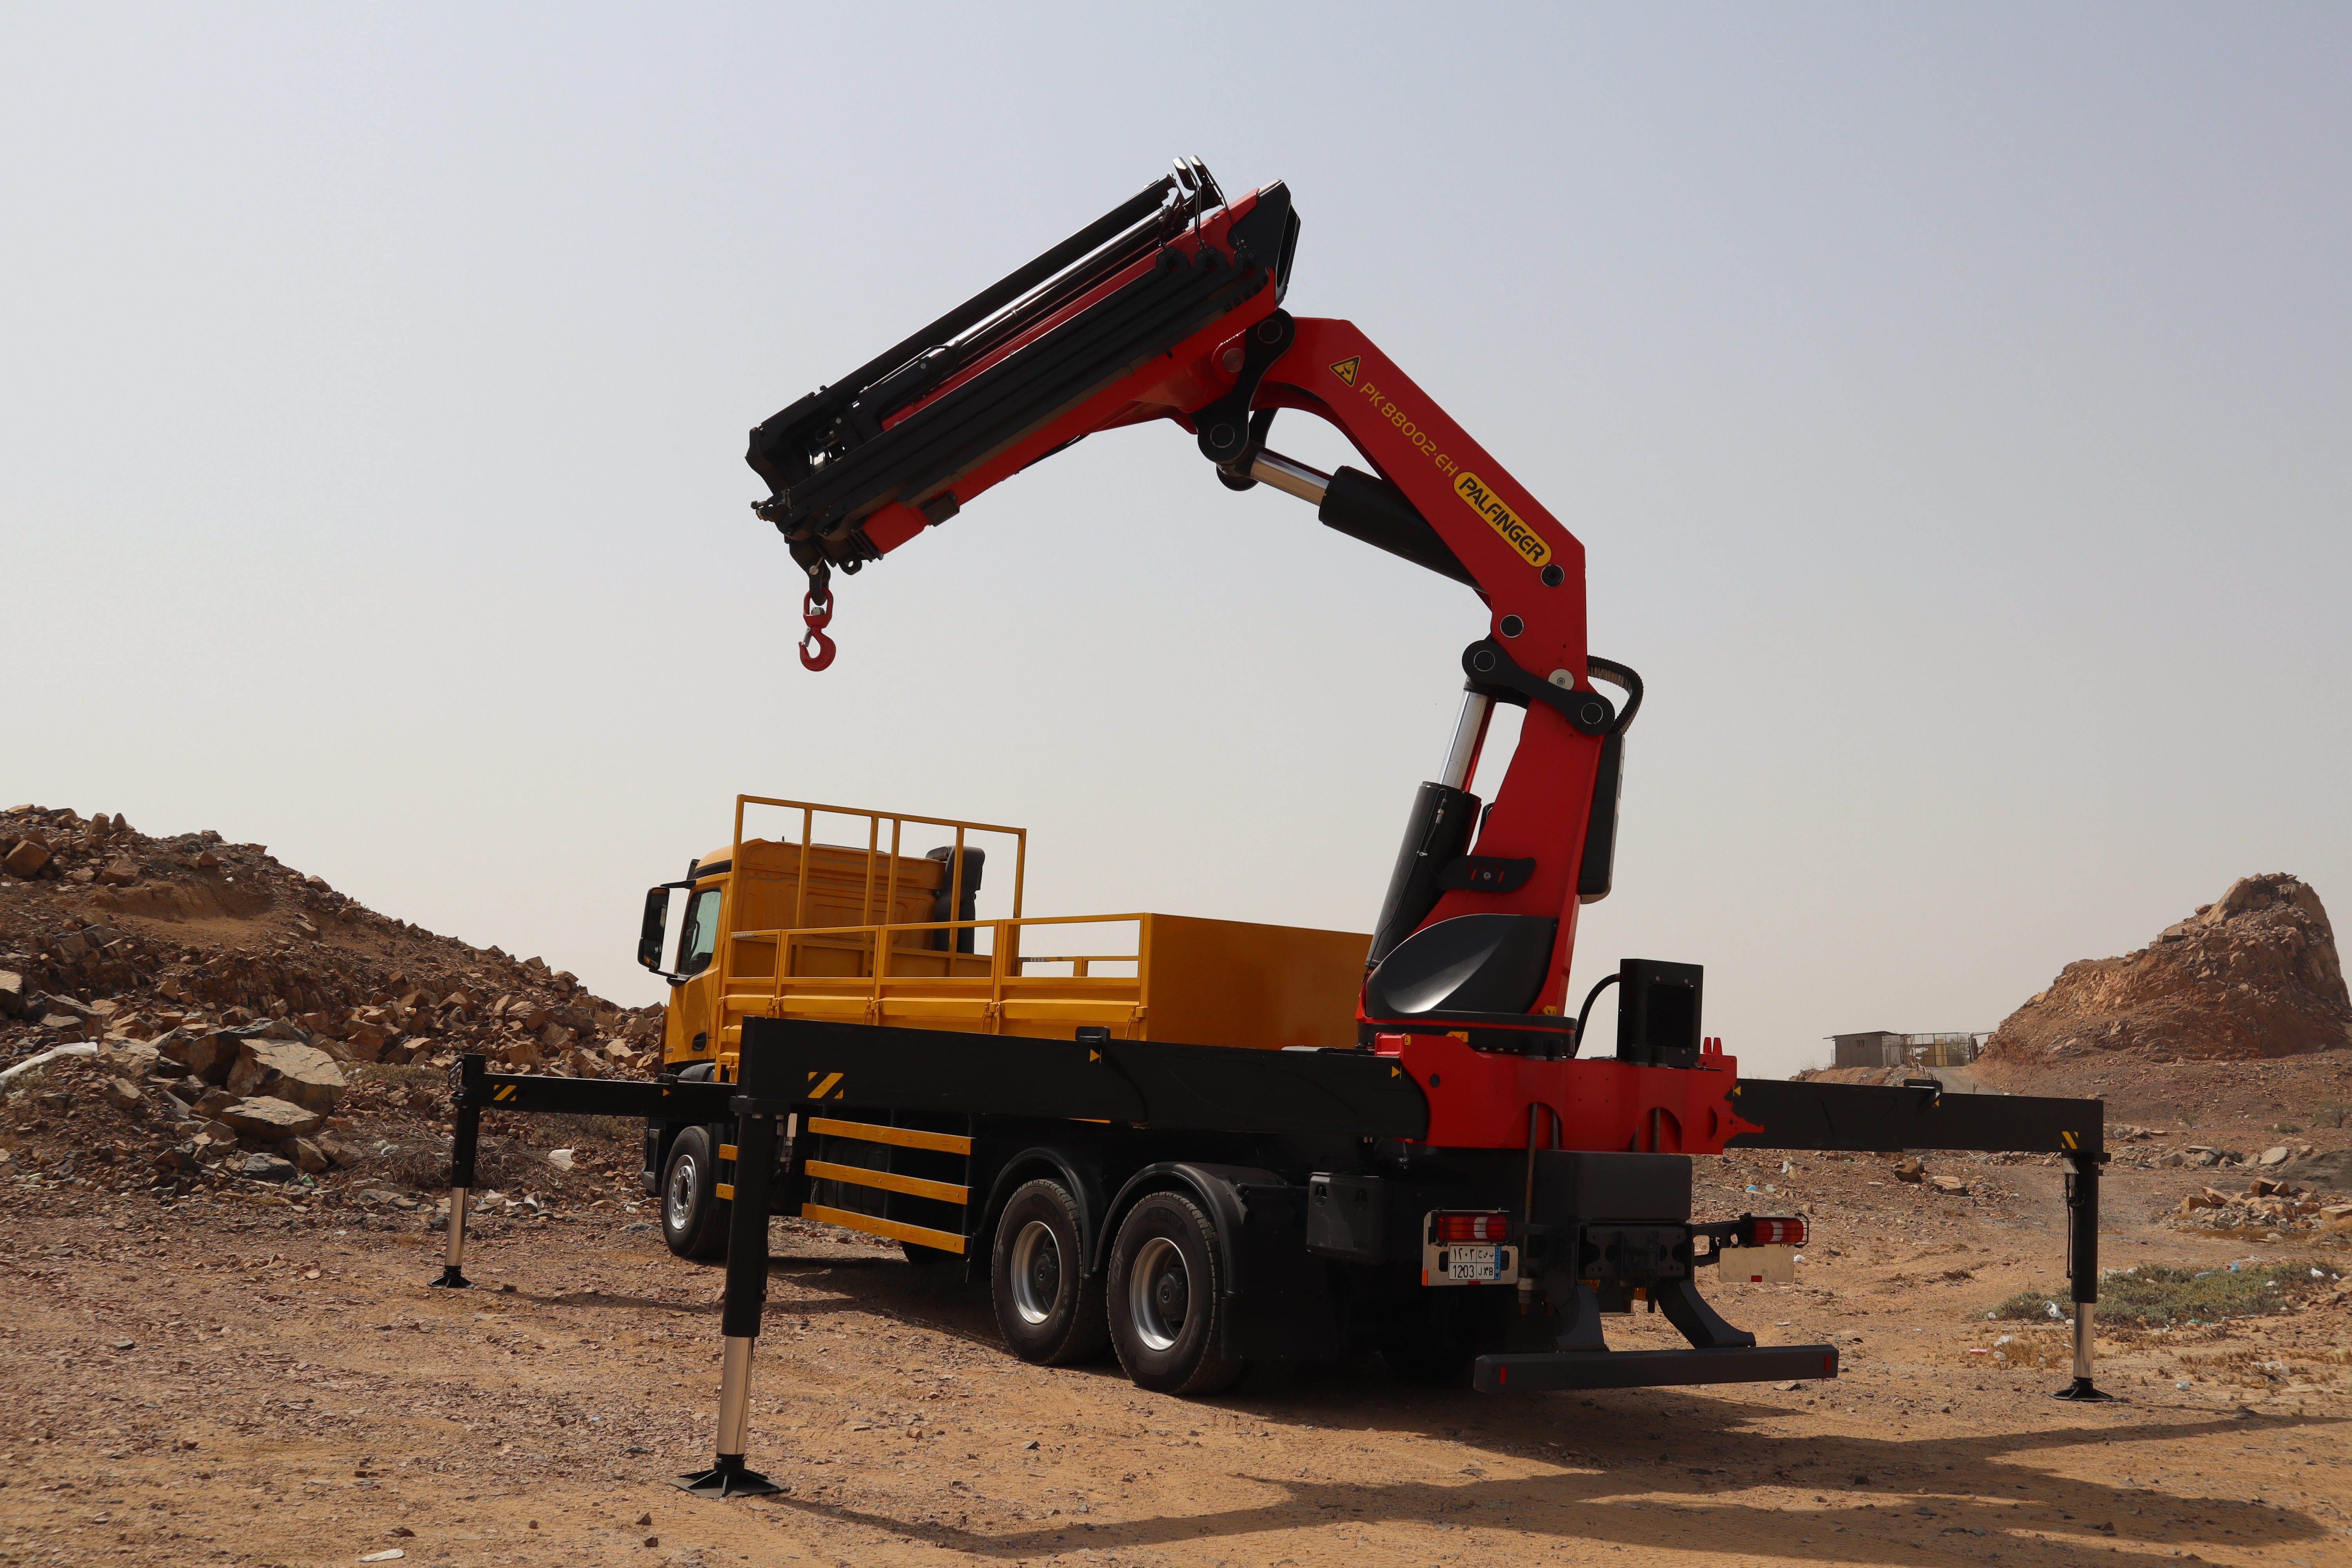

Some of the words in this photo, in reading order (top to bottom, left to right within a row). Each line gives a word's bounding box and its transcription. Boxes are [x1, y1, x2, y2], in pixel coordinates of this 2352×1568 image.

[1359, 382, 1386, 407] PK
[1458, 477, 1545, 563] PALFINGER
[1454, 1248, 1475, 1261] ١٢٠٣
[1453, 1265, 1474, 1278] 1203
